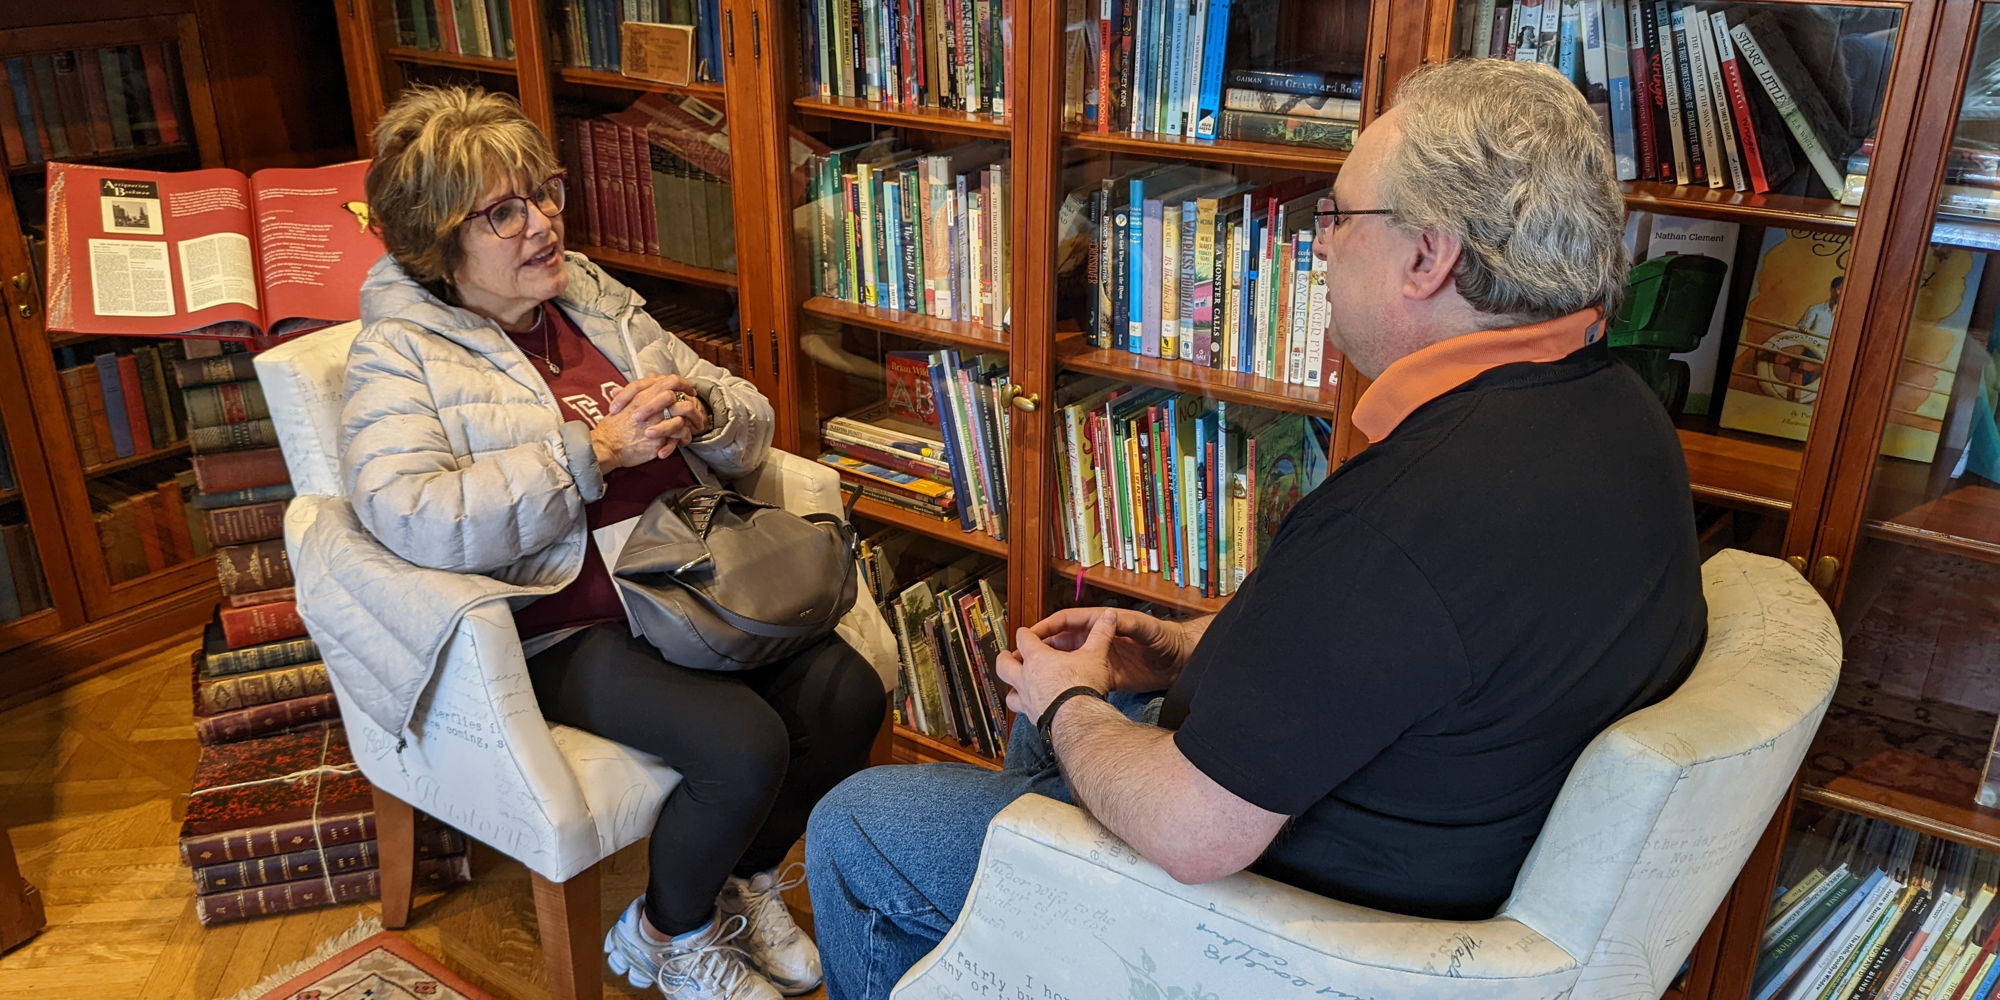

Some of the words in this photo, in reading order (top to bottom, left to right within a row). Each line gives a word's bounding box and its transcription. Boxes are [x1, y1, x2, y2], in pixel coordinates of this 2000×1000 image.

[1645, 9, 1655, 49] SPINELLI
[1676, 32, 1684, 46] THE
[1690, 35, 1699, 50] THE
[1678, 47, 1687, 62] TRUE
[1664, 57, 1677, 97] Gathering
[1693, 52, 1704, 83] TRUMPET
[1735, 30, 1765, 70] STUART
[1759, 69, 1788, 107] LITTLE
[1236, 76, 1262, 84] GAIMAN
[1648, 53, 1666, 110] Wringer
[1680, 63, 1692, 101] CONFESSIONS
[1698, 83, 1706, 93] OF
[1670, 97, 1677, 106] of
[1700, 95, 1708, 108] THE
[1714, 82, 1724, 101] CRICKET
[1671, 107, 1680, 127] Days
[1720, 107, 1728, 123] TIMES
[1687, 110, 1698, 143] CHARLOTTE
[1723, 123, 1732, 141] SQUARE
[1691, 144, 1701, 162] DOYLE
[904, 225, 913, 240] The
[1655, 232, 1686, 241] Nathan
[1688, 233, 1724, 242] Clement
[1102, 239, 1108, 248] TO
[1183, 221, 1194, 271] WATERLESS
[905, 246, 915, 269] Night
[1088, 244, 1099, 284] CROSSOVER
[1164, 256, 1173, 267] It's
[907, 274, 917, 296] Diary
[1164, 268, 1172, 284] like
[1214, 259, 1222, 304] MONSTER
[1182, 273, 1193, 318] MOUNTAIN
[1294, 273, 1307, 333] GAY-NECK
[1163, 301, 1172, 313] cat
[1311, 292, 1322, 336] GINGER
[1309, 340, 1320, 364] PYE
[888, 378, 936, 416] AB
[985, 420, 994, 448] Kitten's
[446, 726, 489, 750] coming,
[1850, 933, 1860, 944] The
[1840, 942, 1854, 957] Hello,
[1874, 948, 1891, 970] SEVEN
[958, 952, 1006, 991] fairly
[1827, 954, 1845, 975] Goodbye
[941, 957, 962, 981] any
[971, 981, 988, 995] of
[1815, 974, 1831, 991] Window
[1858, 972, 1876, 992] BLIND
